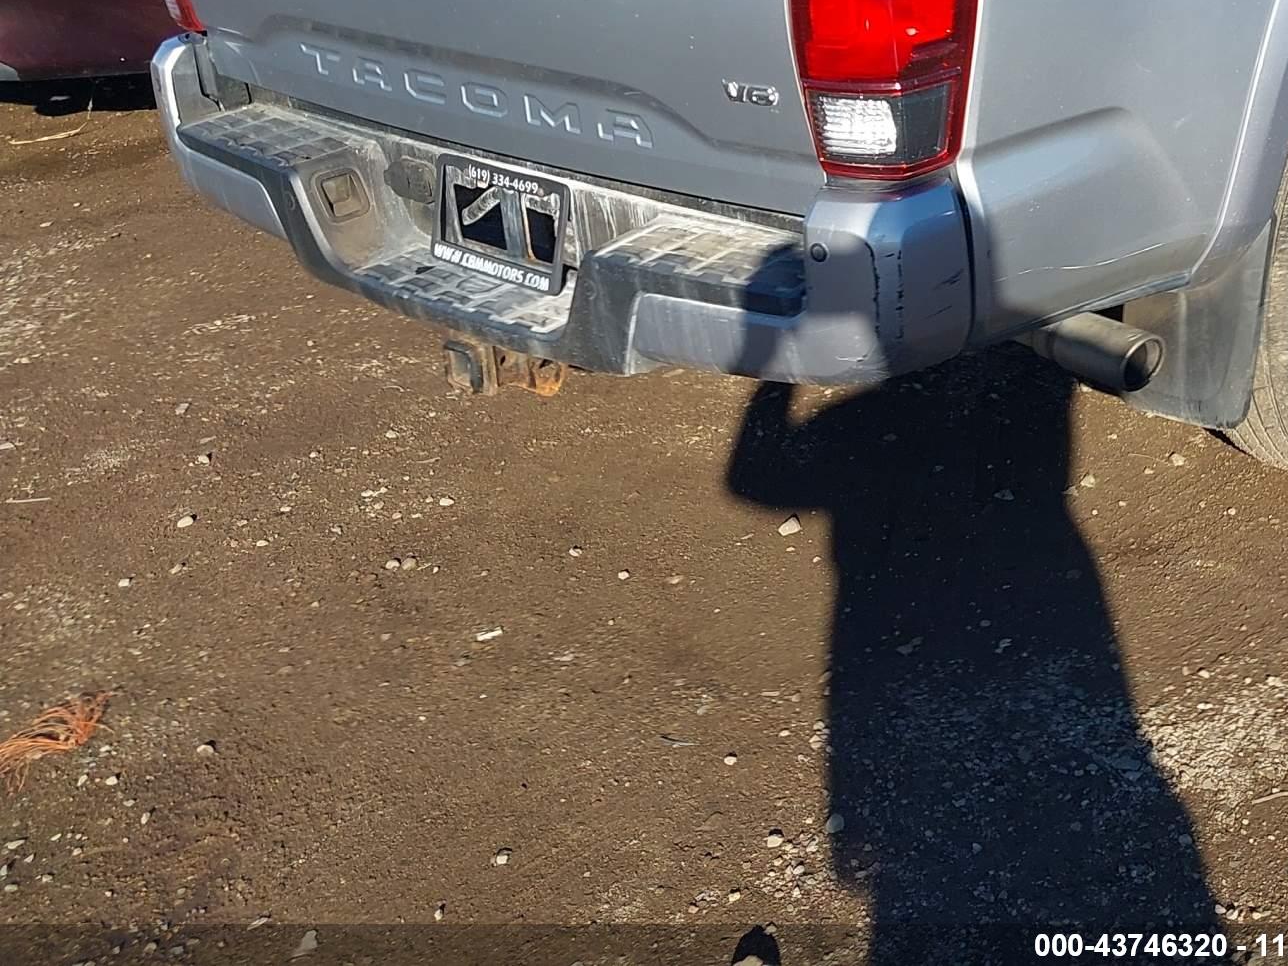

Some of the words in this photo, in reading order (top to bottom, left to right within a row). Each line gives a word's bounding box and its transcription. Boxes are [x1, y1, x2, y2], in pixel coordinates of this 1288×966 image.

[300, 42, 655, 150] TACOMA
[722, 79, 779, 107] V6
[468, 164, 490, 185] (619)
[492, 173, 538, 194] 334-4699
